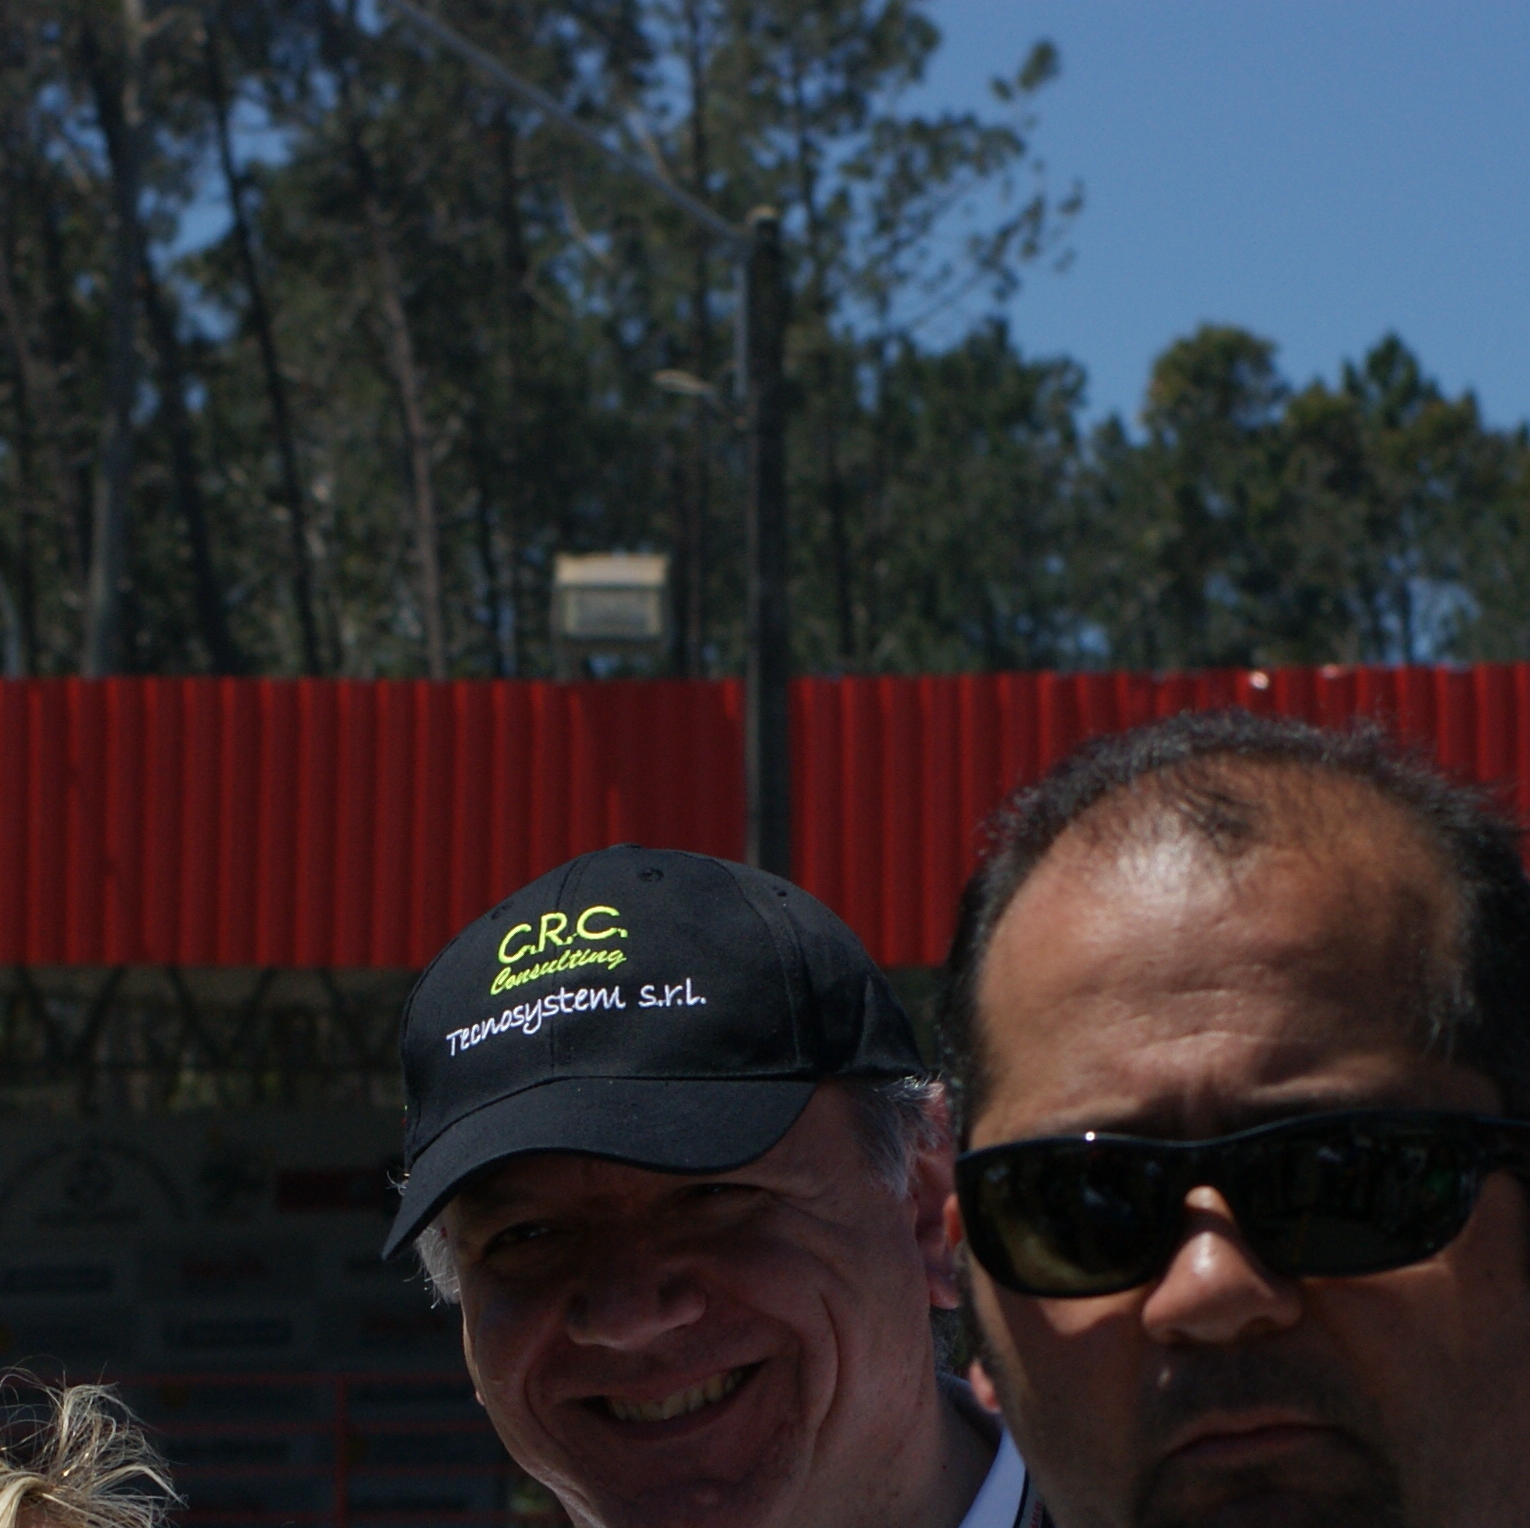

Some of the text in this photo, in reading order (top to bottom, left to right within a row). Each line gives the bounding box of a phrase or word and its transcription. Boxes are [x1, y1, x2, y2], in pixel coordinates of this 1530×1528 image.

[497, 905, 628, 965] C.R.C.
[489, 948, 627, 996] Consulting
[445, 977, 707, 1056] Tecnosystem s.r.l.
